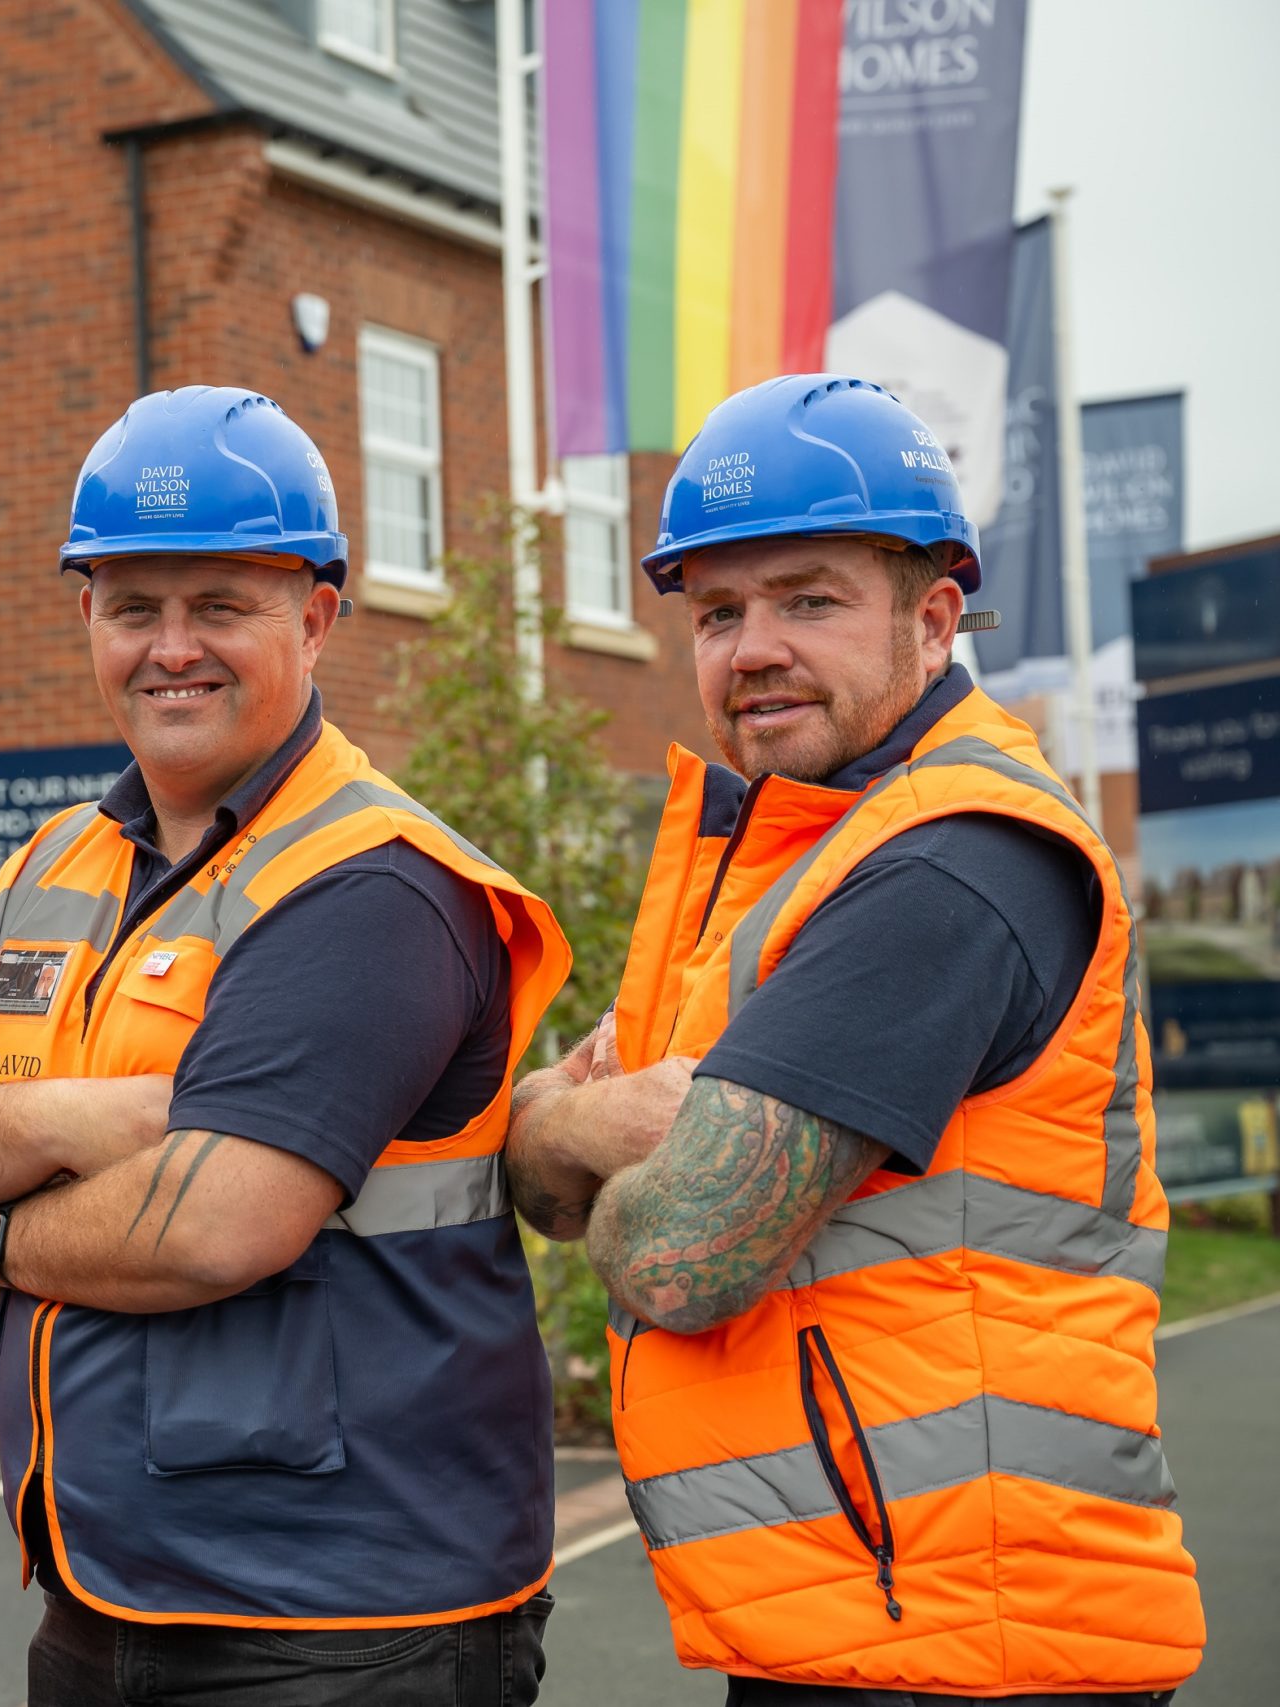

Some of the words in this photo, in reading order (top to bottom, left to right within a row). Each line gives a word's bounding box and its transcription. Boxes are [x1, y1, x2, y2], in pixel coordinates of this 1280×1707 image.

[842, 0, 995, 38] ILSON
[912, 430, 937, 448] DEA
[708, 452, 749, 471] DAVID
[142, 465, 184, 479] DAVID
[702, 464, 755, 487] WILSON
[135, 479, 190, 493] WILSON
[703, 480, 752, 502] HOMES
[137, 493, 187, 508] HOMES
[9, 776, 67, 807] OUR
